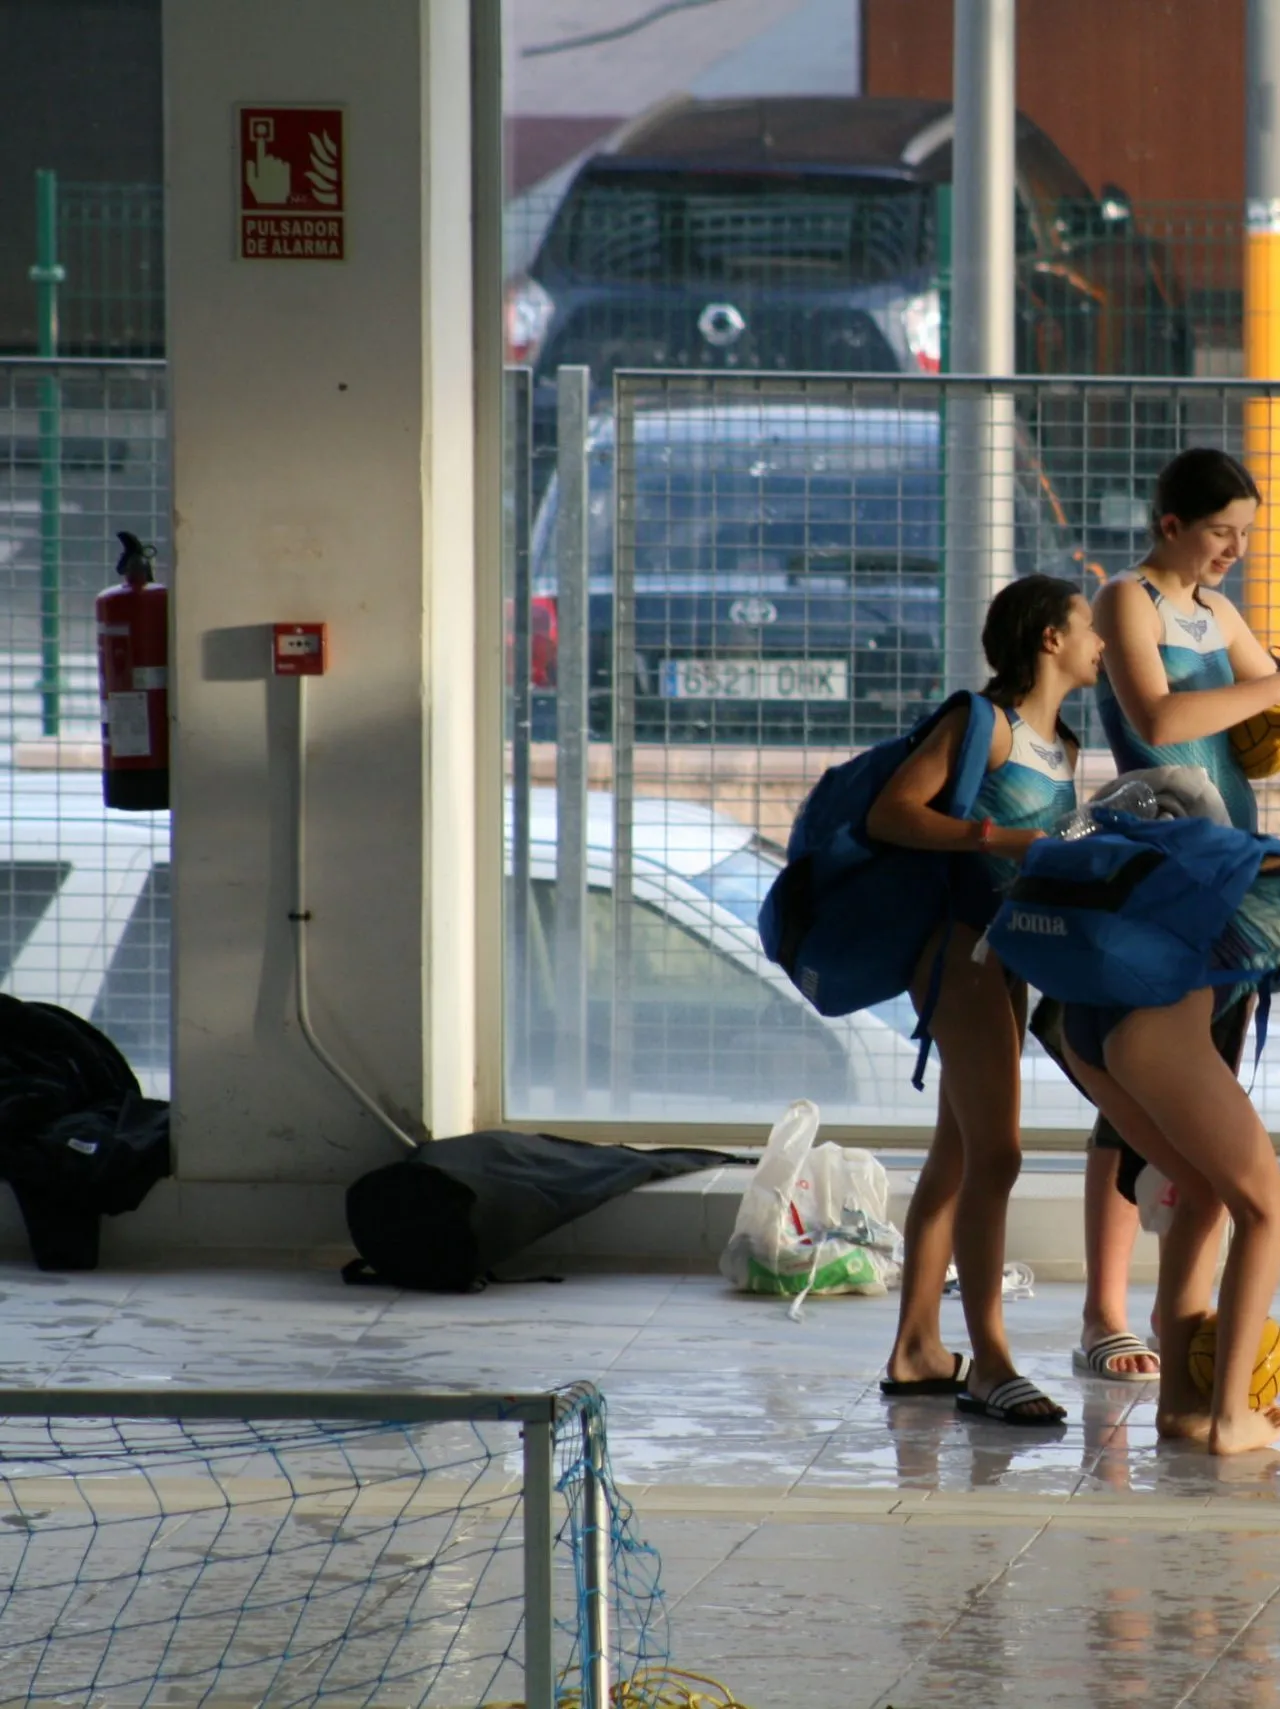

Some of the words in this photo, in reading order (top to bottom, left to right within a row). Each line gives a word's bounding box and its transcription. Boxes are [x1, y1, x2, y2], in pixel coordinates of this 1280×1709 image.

[246, 220, 340, 237] PULSADOR
[246, 238, 268, 255] DE
[272, 238, 340, 256] ALARMA
